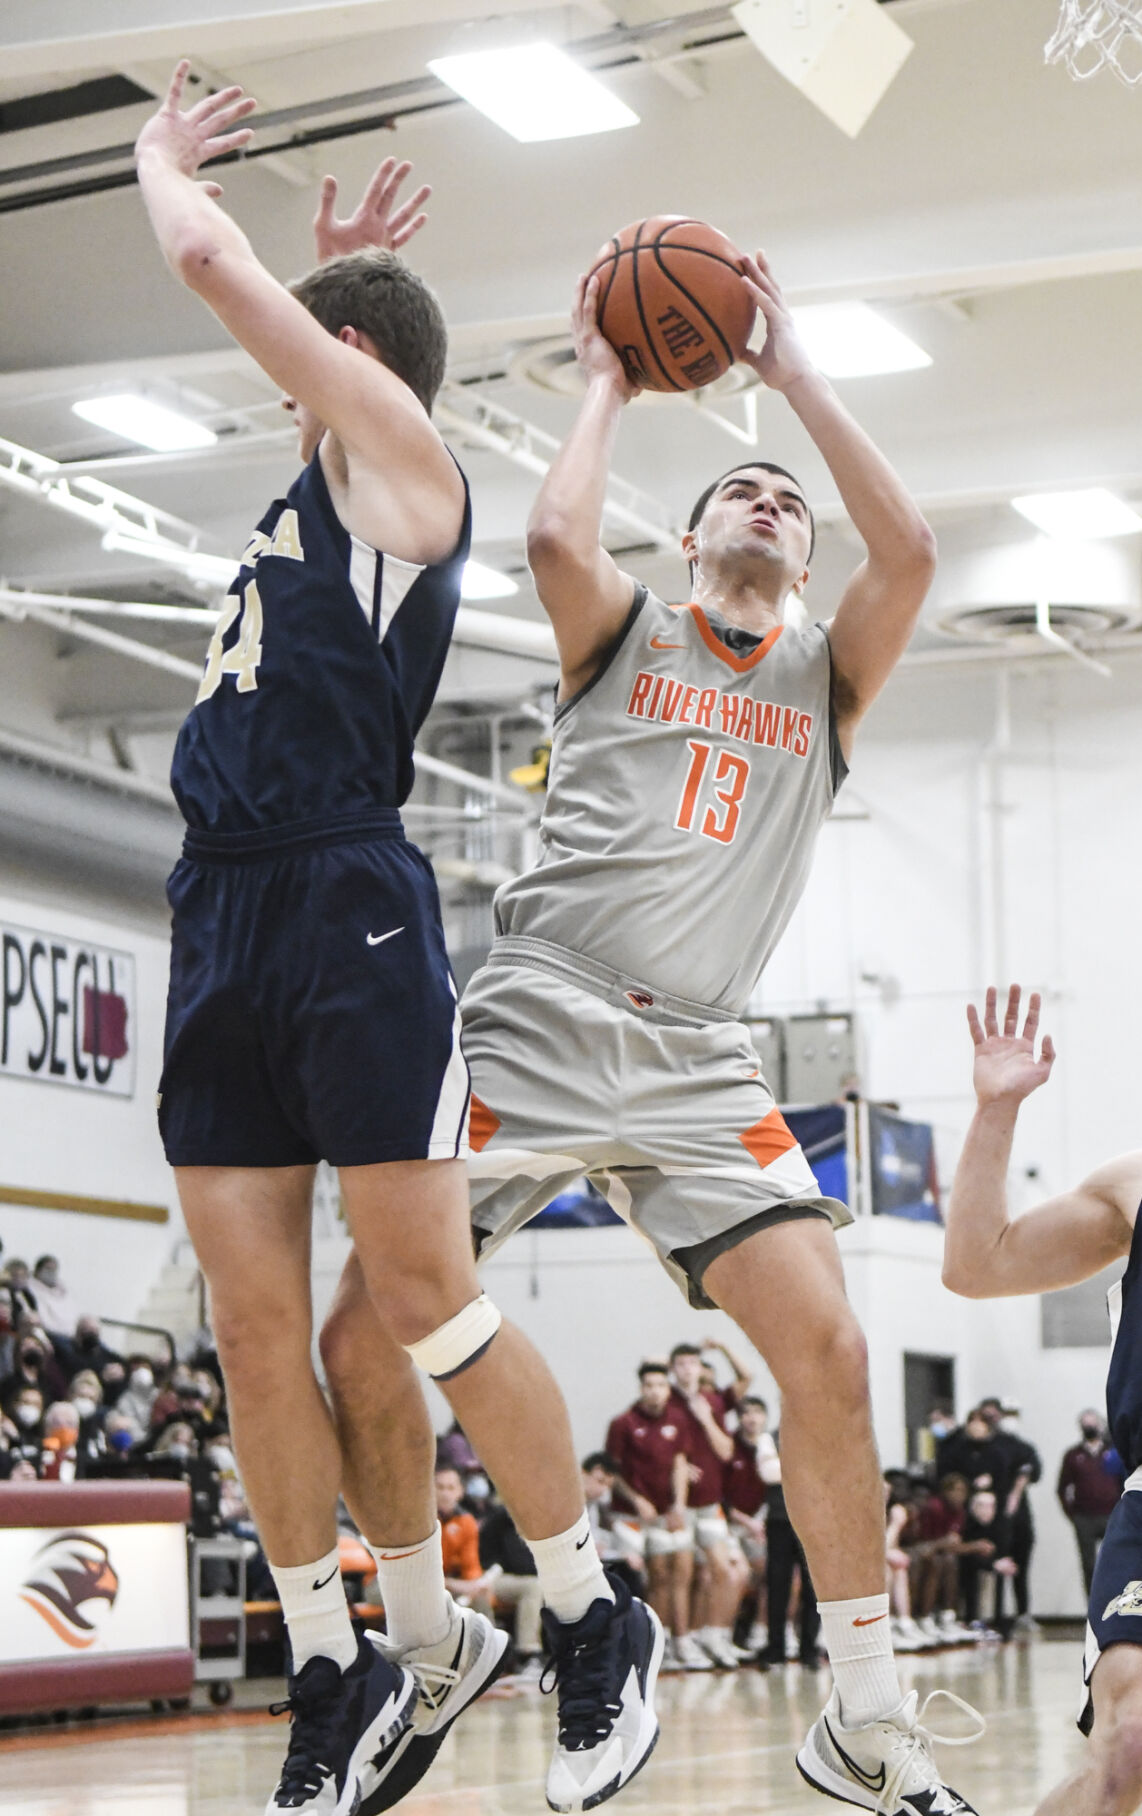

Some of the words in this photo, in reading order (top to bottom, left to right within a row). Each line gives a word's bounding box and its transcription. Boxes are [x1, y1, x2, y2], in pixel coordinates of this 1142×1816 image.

[657, 305, 705, 359] THE
[673, 738, 752, 846] 13
[1, 932, 116, 1085] PSECU
